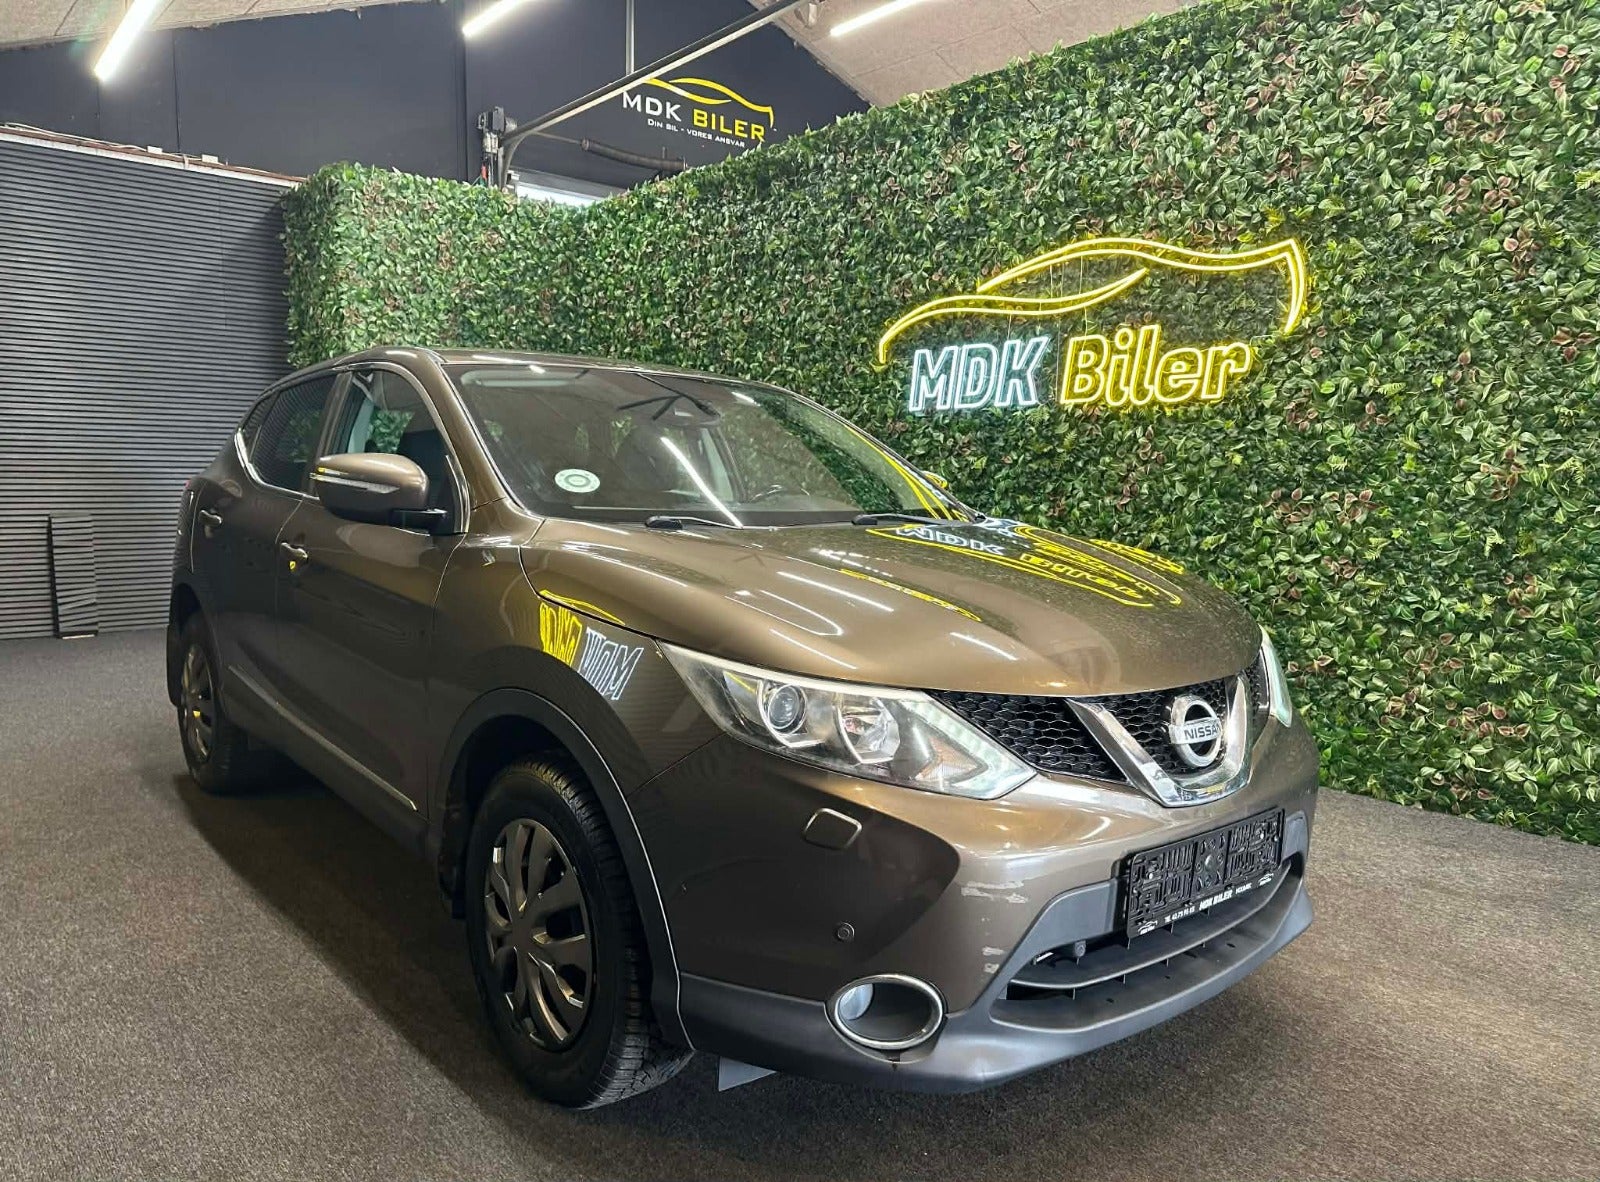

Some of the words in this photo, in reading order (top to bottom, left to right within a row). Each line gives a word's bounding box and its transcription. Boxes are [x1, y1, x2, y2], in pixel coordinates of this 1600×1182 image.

[622, 91, 682, 122] MDK
[693, 108, 765, 142] BILER
[666, 123, 679, 132] BIL
[686, 128, 713, 140] VORES
[714, 134, 745, 148] ANSVAR
[908, 334, 1050, 412] MDK
[1060, 323, 1251, 406] Biler
